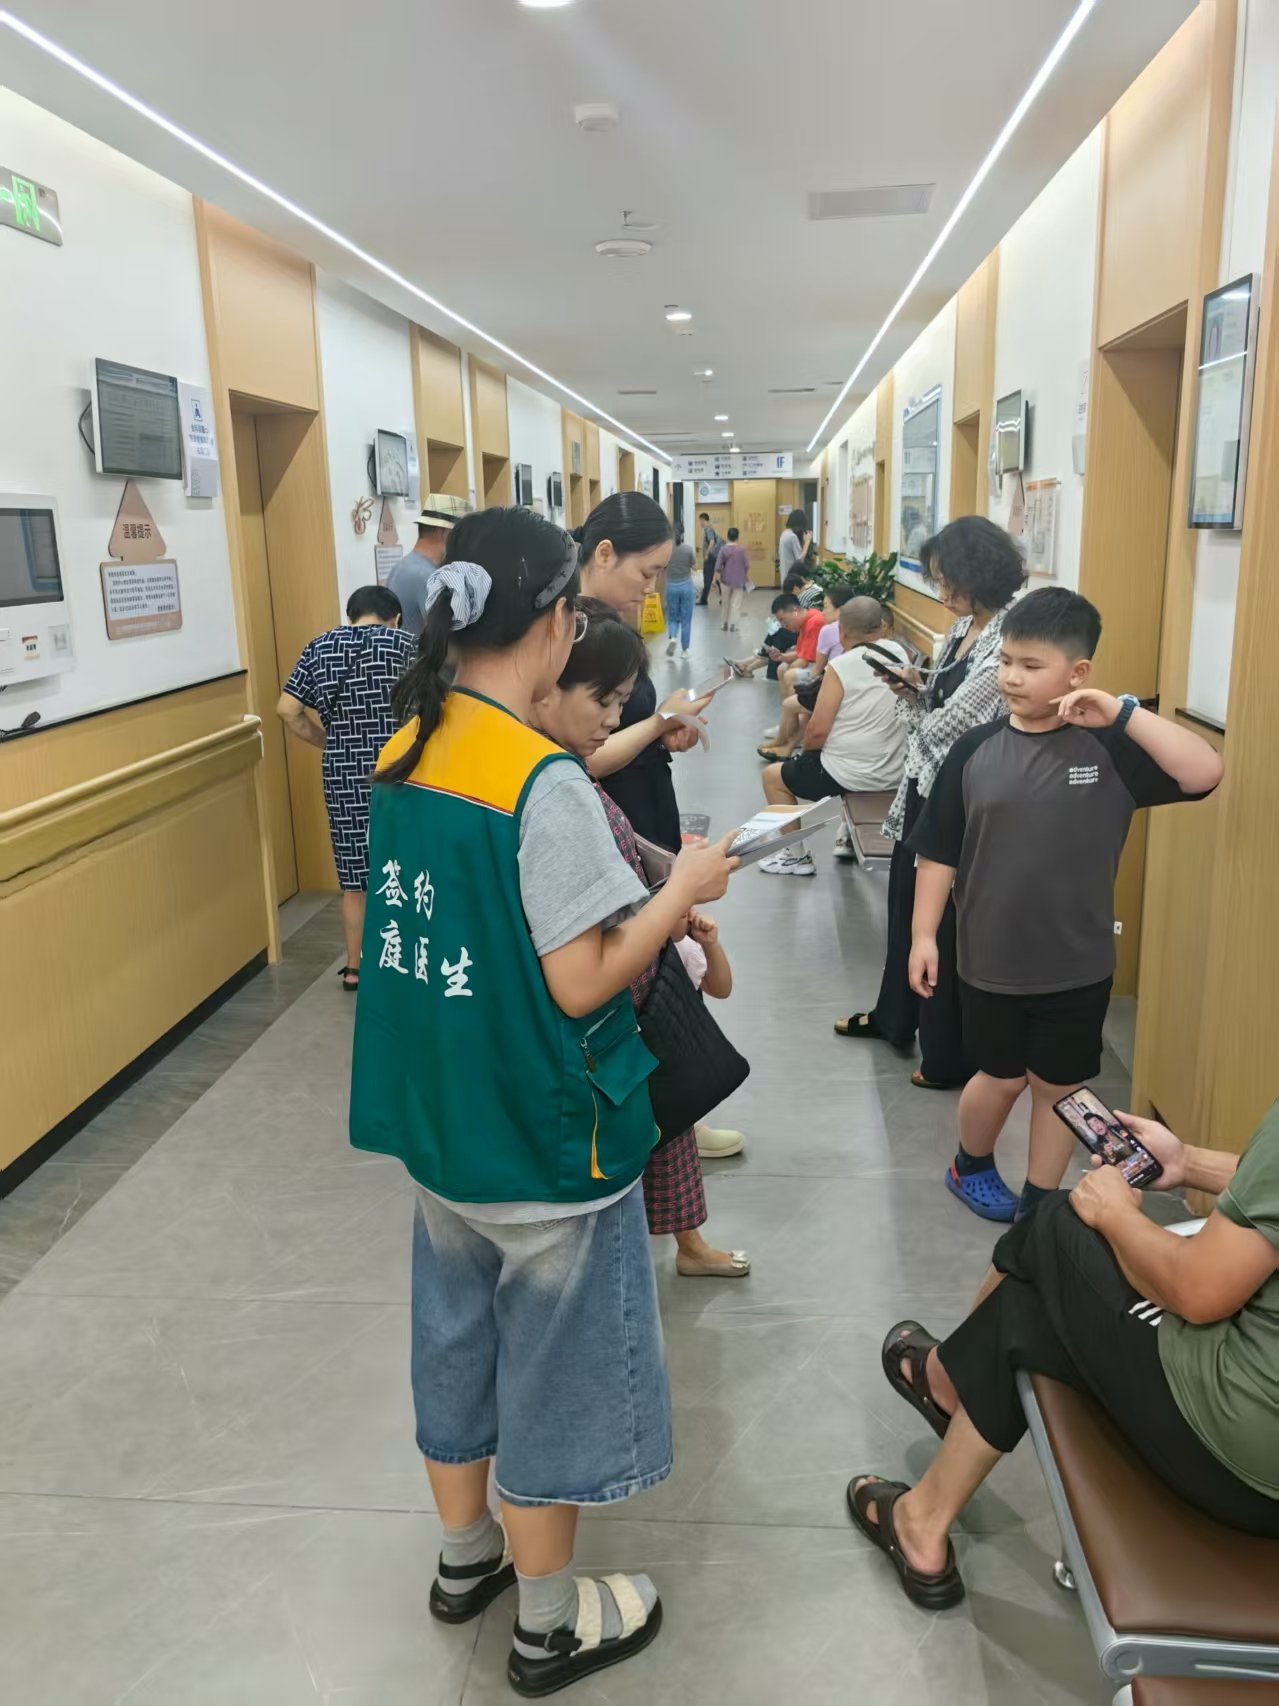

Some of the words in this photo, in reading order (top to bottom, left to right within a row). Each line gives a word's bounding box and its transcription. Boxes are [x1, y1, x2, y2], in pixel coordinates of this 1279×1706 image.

[375, 859, 435, 920] 签约
[361, 919, 473, 997] 庭医生
